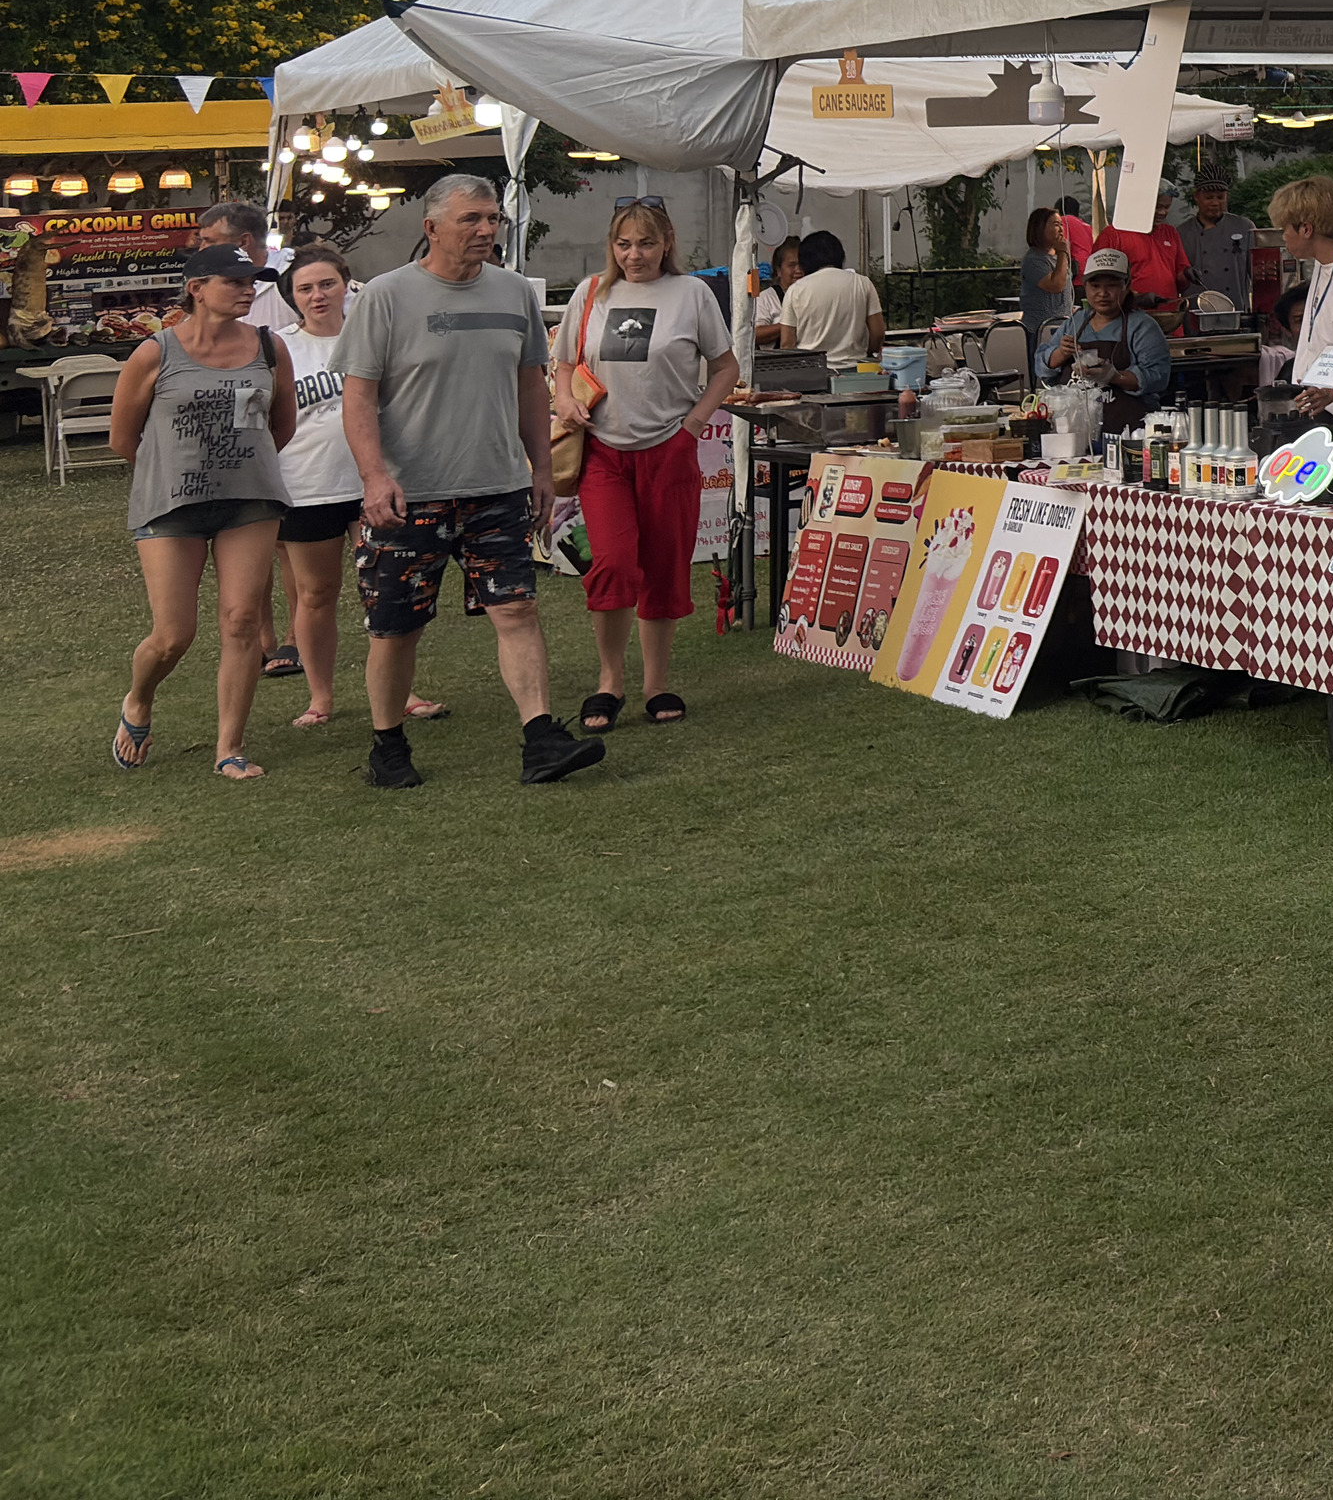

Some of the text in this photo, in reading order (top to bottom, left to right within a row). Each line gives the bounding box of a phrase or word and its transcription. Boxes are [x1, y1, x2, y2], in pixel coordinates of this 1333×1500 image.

[819, 91, 887, 112] CANE SAUSAGE
[44, 213, 199, 235] CROCODILE GRILL
[72, 248, 175, 264] Should Try Before die!
[56, 266, 118, 276] Hight Protein
[240, 379, 253, 387] IS
[194, 389, 235, 400] DURI
[176, 401, 235, 414] DARKES
[176, 424, 214, 439] THAT
[200, 435, 238, 449] MUST
[208, 447, 255, 459] FOCUS
[200, 459, 243, 471] TO SEE
[181, 472, 209, 486] THE
[1006, 497, 1076, 530] FRESH LIKE DOGGY!
